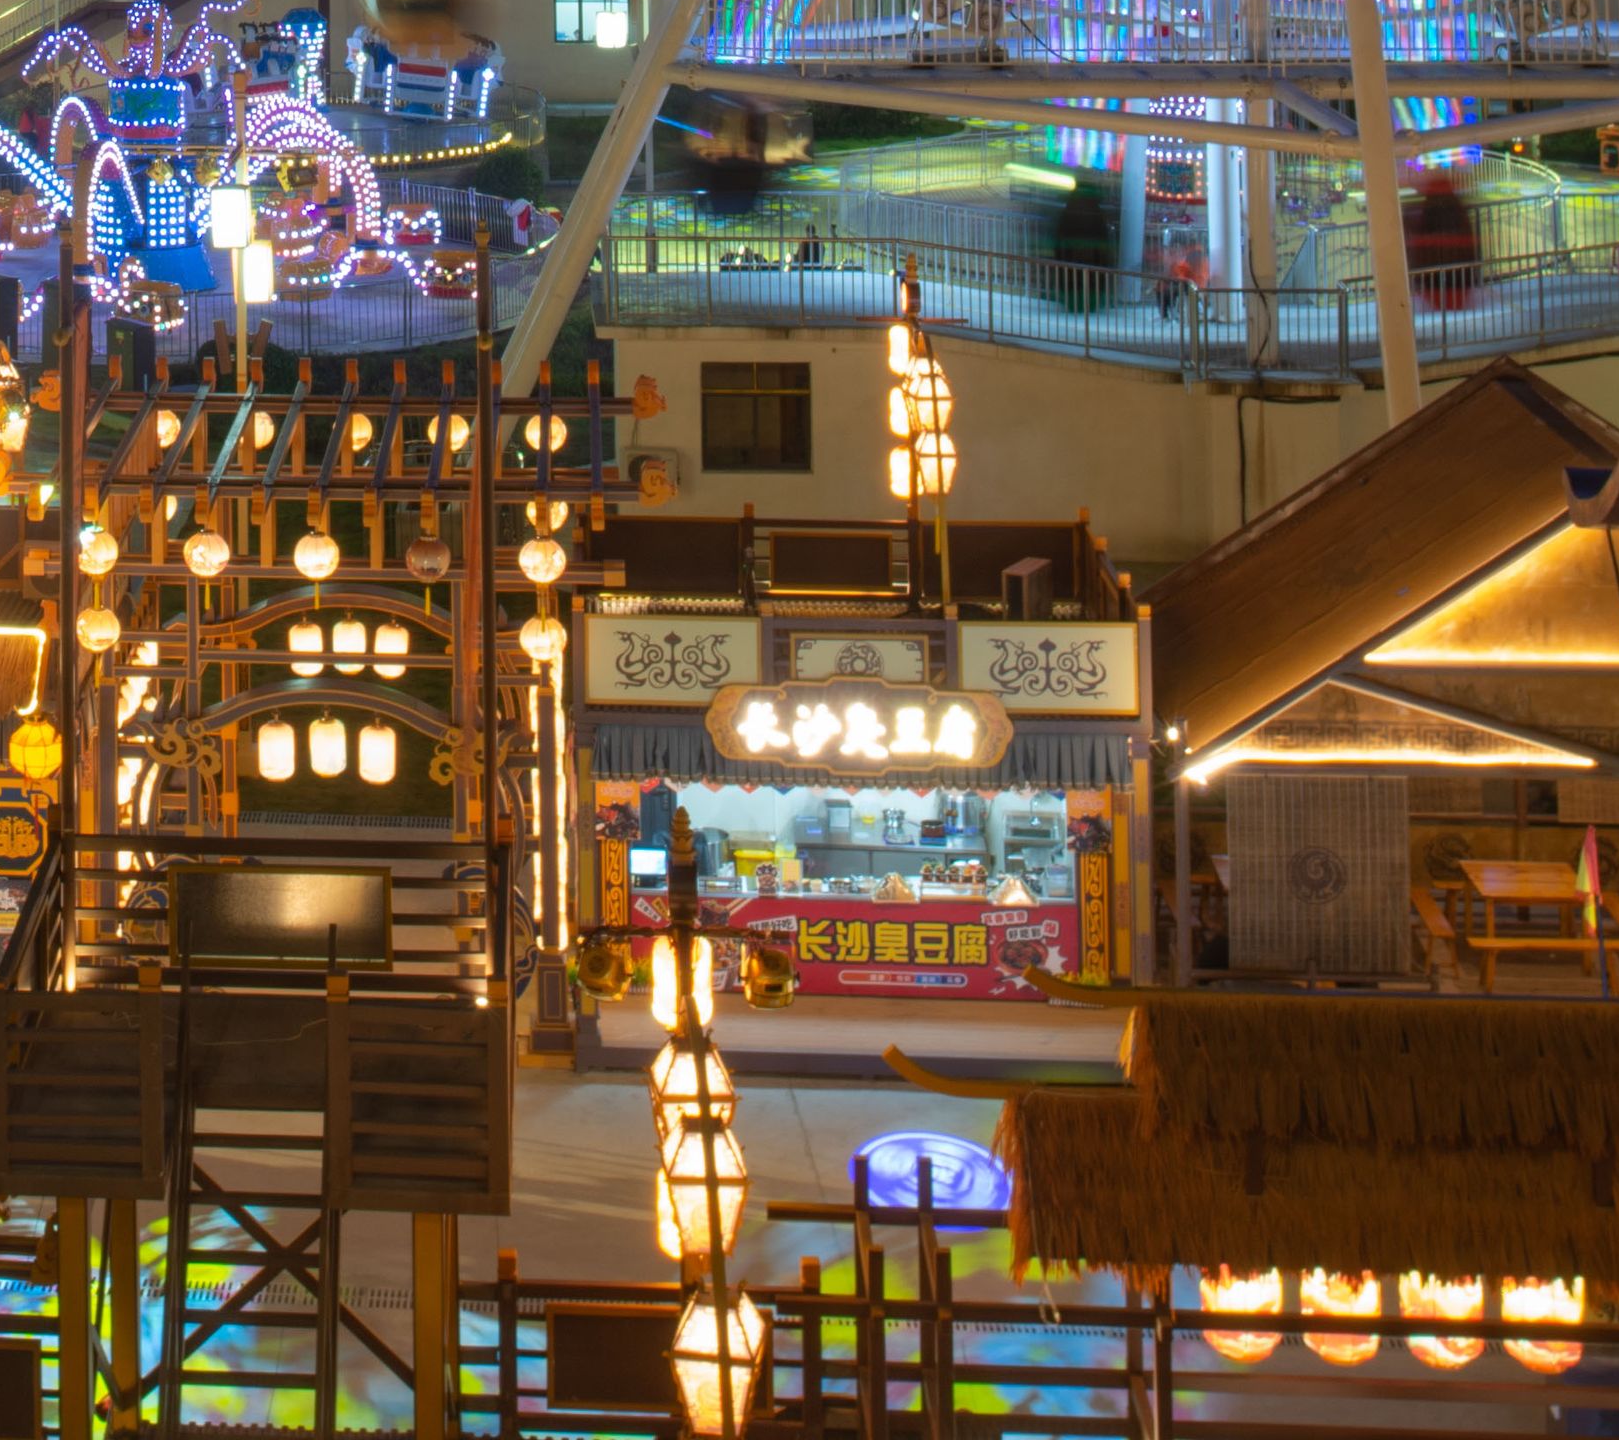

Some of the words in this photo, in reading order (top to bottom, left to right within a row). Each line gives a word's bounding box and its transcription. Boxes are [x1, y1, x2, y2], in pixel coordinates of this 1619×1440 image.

[737, 701, 976, 760] 长沙臭豆腐
[797, 918, 990, 967] 长沙臭豆腐
